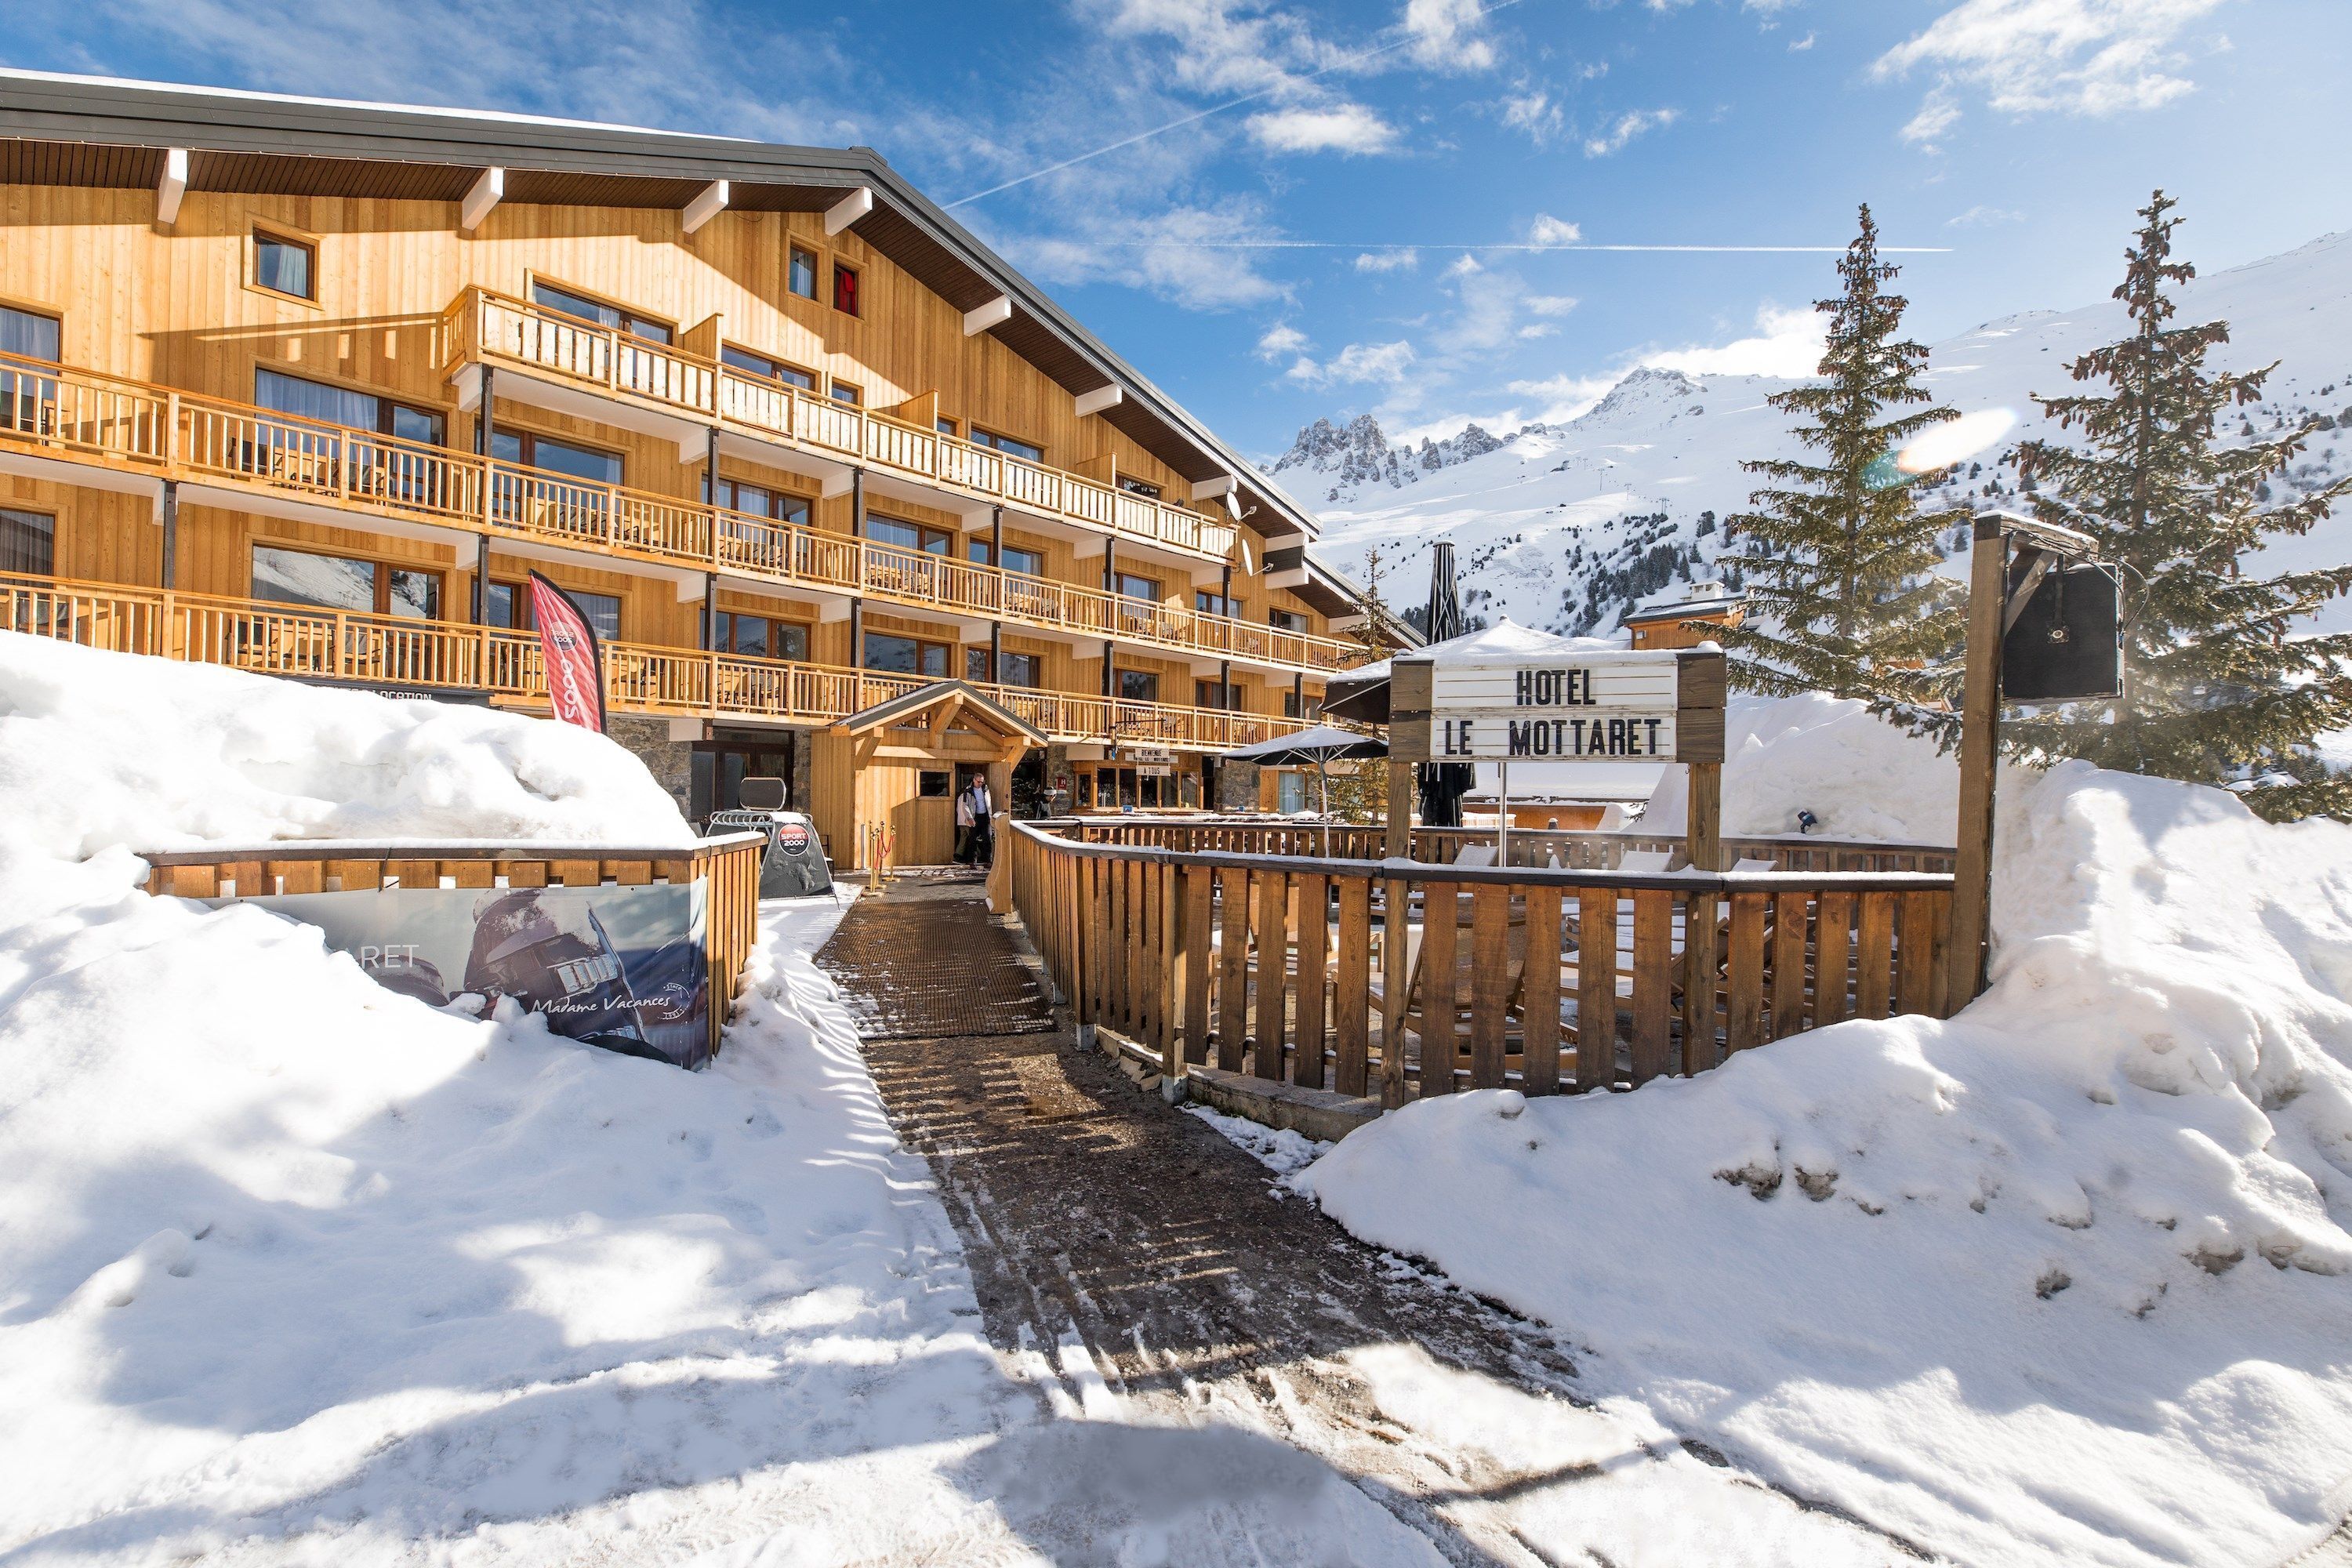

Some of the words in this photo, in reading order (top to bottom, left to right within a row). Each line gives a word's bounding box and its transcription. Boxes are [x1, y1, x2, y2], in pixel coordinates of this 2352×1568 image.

[1516, 670, 1596, 705] HOTEL
[1445, 720, 1473, 755] LE
[1509, 718, 1661, 756] MOTTARET
[346, 944, 420, 970] RET
[532, 996, 599, 1014] Madame
[603, 994, 671, 1011] Vacances
